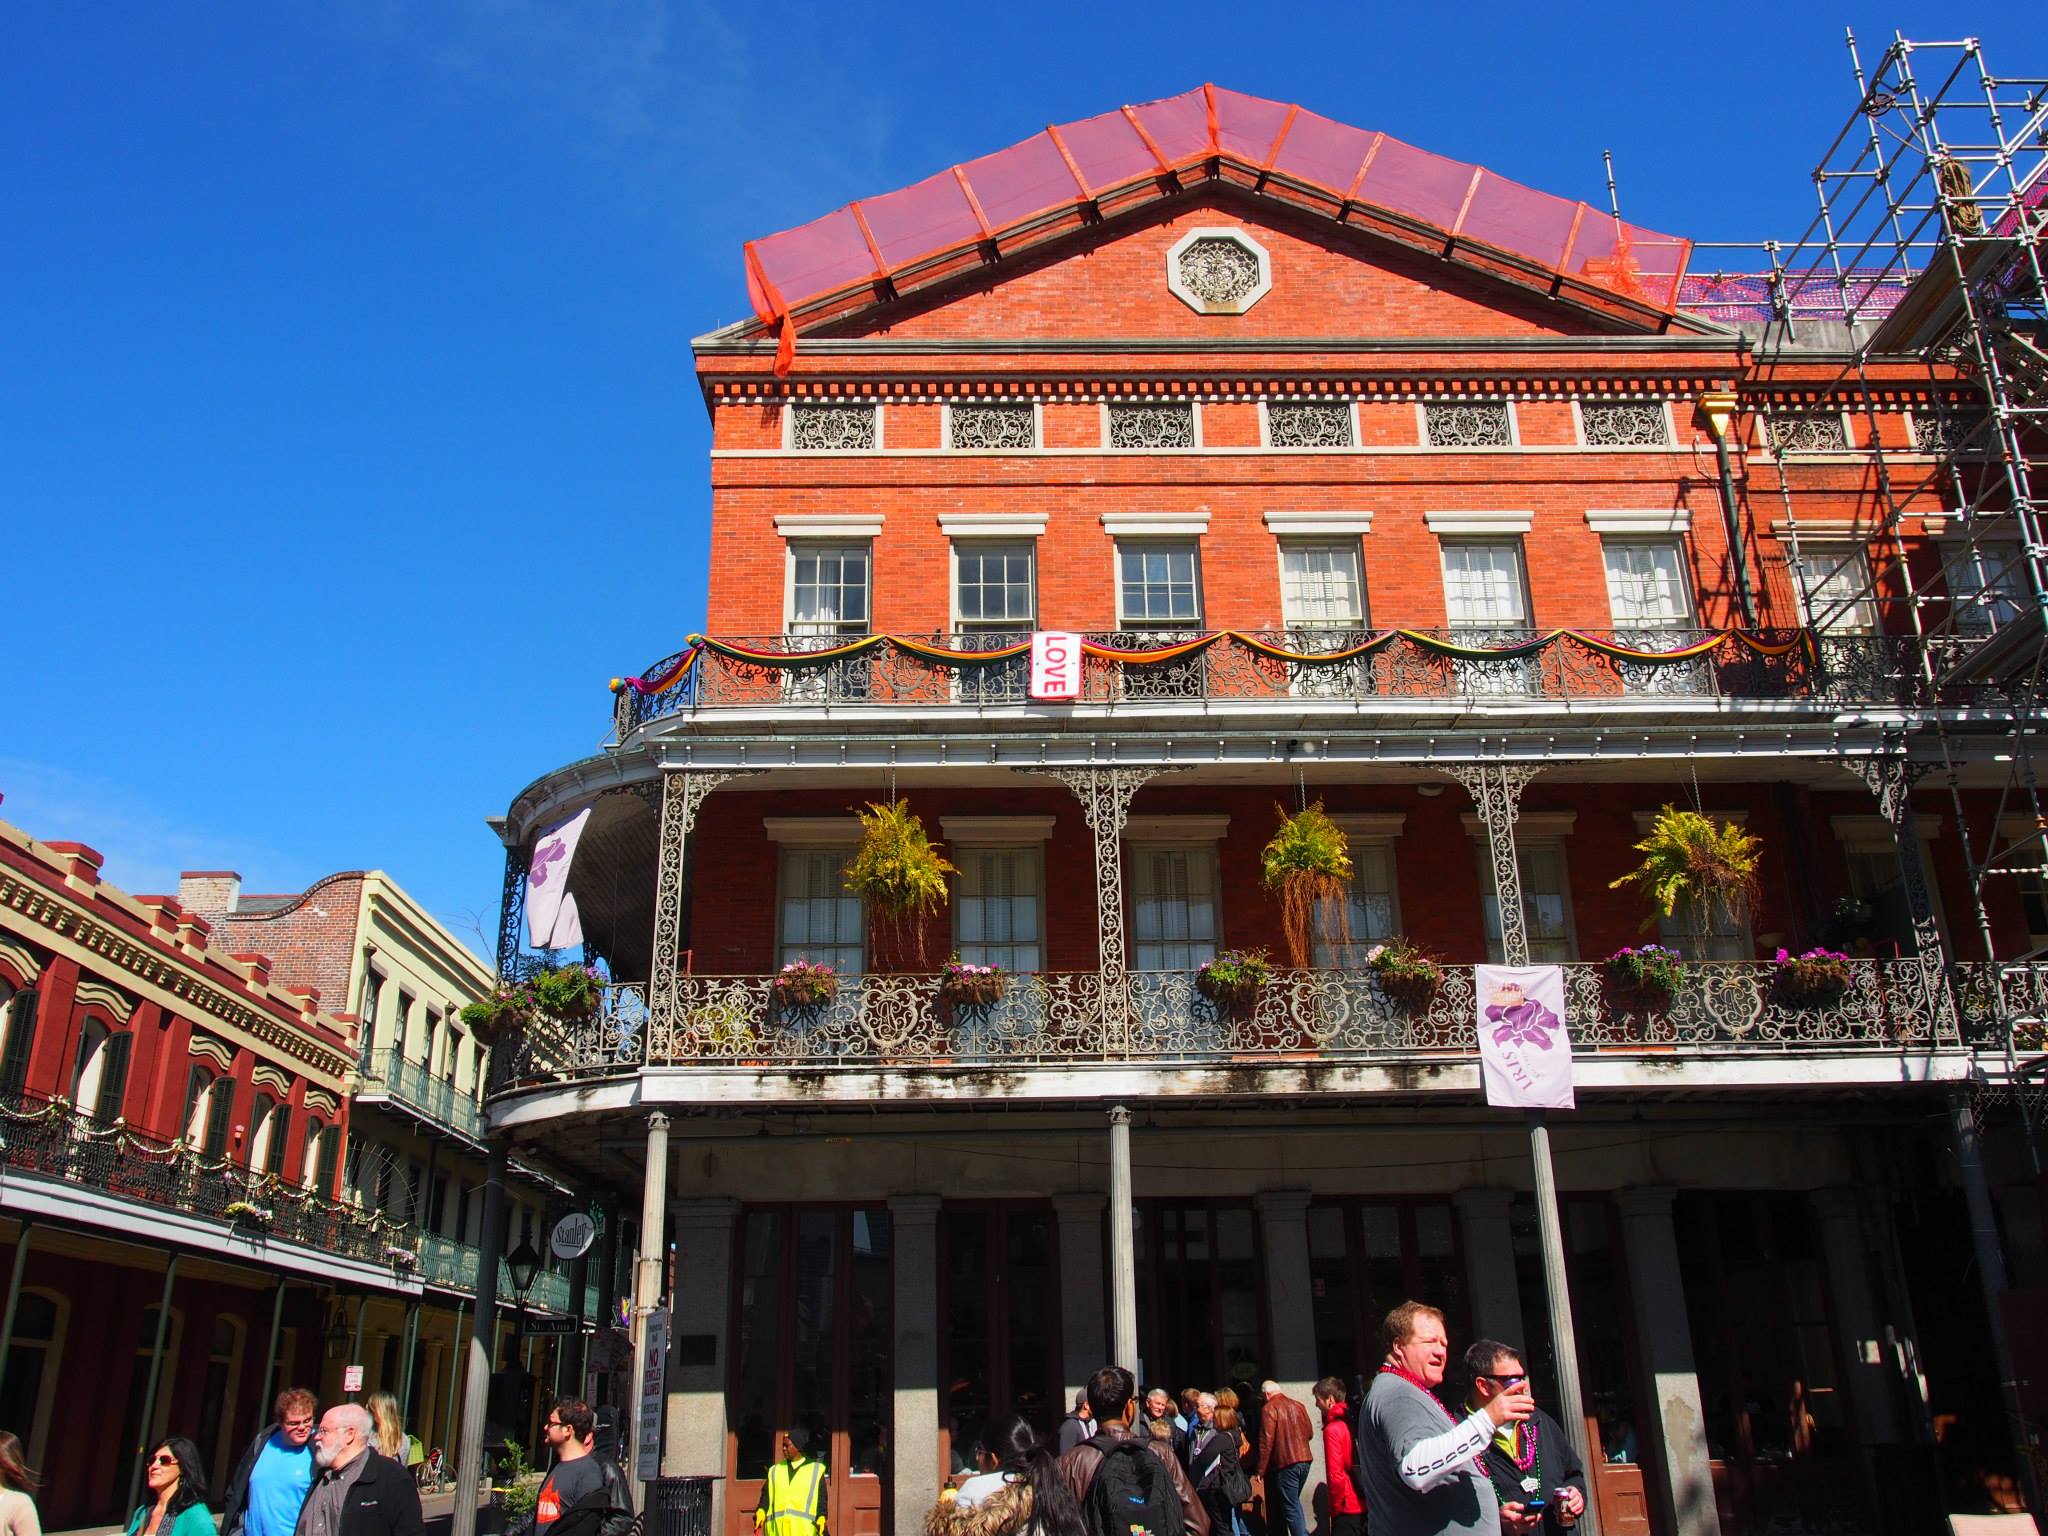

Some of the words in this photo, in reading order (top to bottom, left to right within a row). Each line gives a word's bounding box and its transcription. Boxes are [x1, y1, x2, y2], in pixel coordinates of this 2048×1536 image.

[1044, 636, 1067, 693] LOVE
[1501, 1051, 1534, 1091] IRIS
[555, 1216, 588, 1250] Stanley
[649, 1347, 659, 1369] NO
